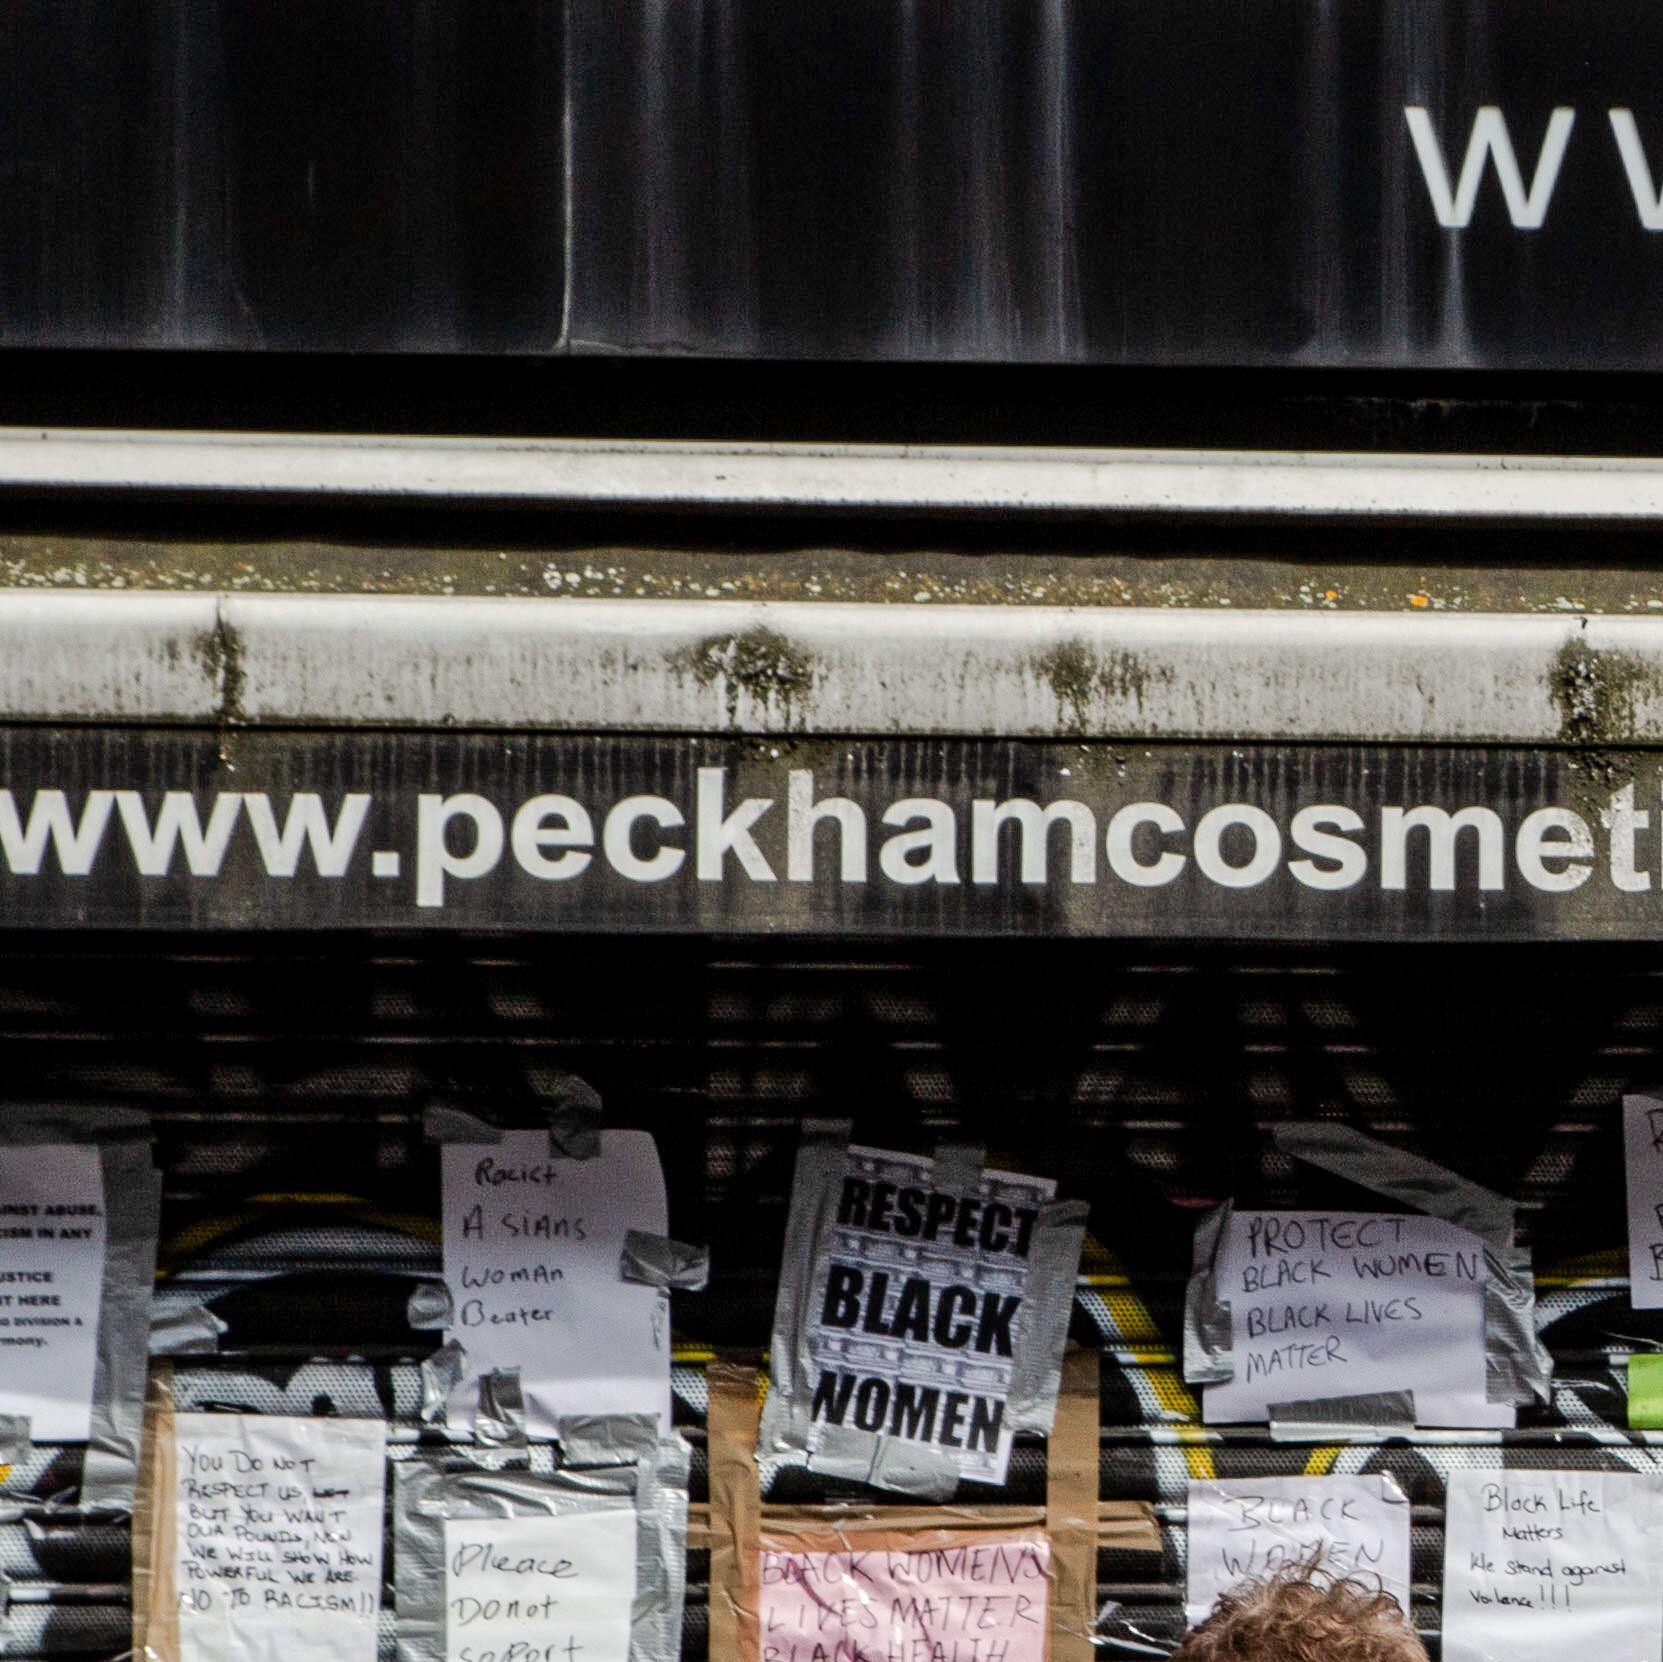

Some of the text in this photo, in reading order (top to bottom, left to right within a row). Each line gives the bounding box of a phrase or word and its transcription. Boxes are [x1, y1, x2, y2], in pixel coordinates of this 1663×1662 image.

[837, 1175, 1039, 1259] RESPECT
[1247, 1216, 1405, 1258] PROTECT
[1242, 1252, 1480, 1293] BLACK WOMEN
[821, 1263, 1022, 1357] BLACK
[1246, 1297, 1423, 1339] BLACK LIVES
[1246, 1335, 1349, 1384] MATTER
[182, 1445, 223, 1474] YOU
[1559, 1489, 1601, 1514] Life
[1502, 1526, 1564, 1542] Matters
[768, 1594, 1039, 1633] LIVES MATTER
